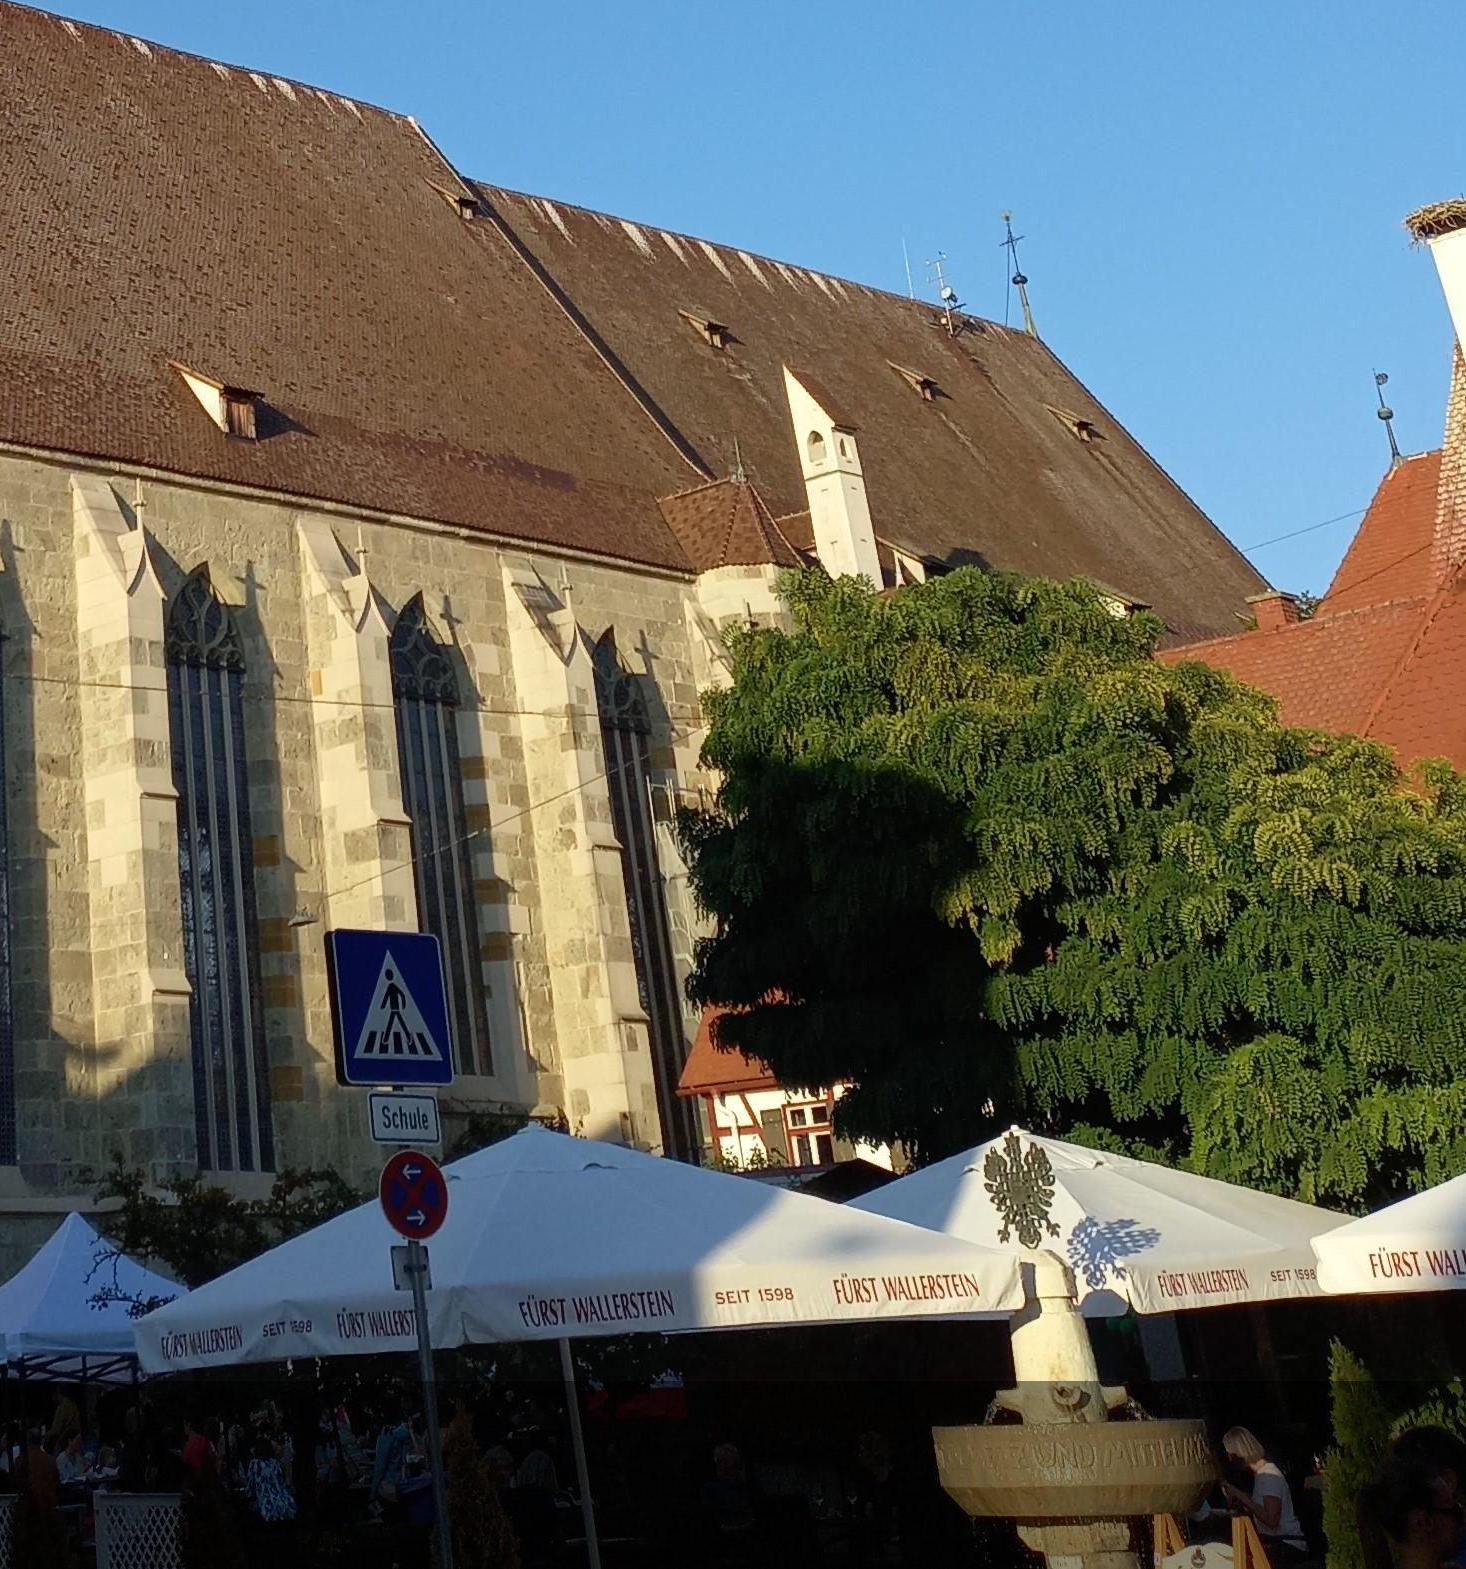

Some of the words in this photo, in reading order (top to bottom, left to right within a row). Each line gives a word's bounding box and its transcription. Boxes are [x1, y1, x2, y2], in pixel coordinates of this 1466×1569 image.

[381, 1104, 429, 1130] Schule
[1269, 1269, 1291, 1282] SEIT
[1294, 1268, 1317, 1281] 1598
[1368, 1248, 1422, 1278] FÜRST
[715, 1289, 751, 1305] SEIT
[758, 1287, 795, 1303] 1598
[832, 1272, 879, 1305] FÜRST
[881, 1273, 981, 1301] WALLERSTEIN
[1157, 1269, 1188, 1298] FÜRST
[1188, 1268, 1250, 1294] WALLERSTEIN
[336, 1307, 367, 1338] FÜRST
[367, 1309, 416, 1337] WALLERST
[518, 1295, 567, 1328] FÜRST
[572, 1290, 675, 1324] WALLERSTEIN
[262, 1321, 286, 1337] SEIT
[1031, 1440, 1098, 1469] UND
